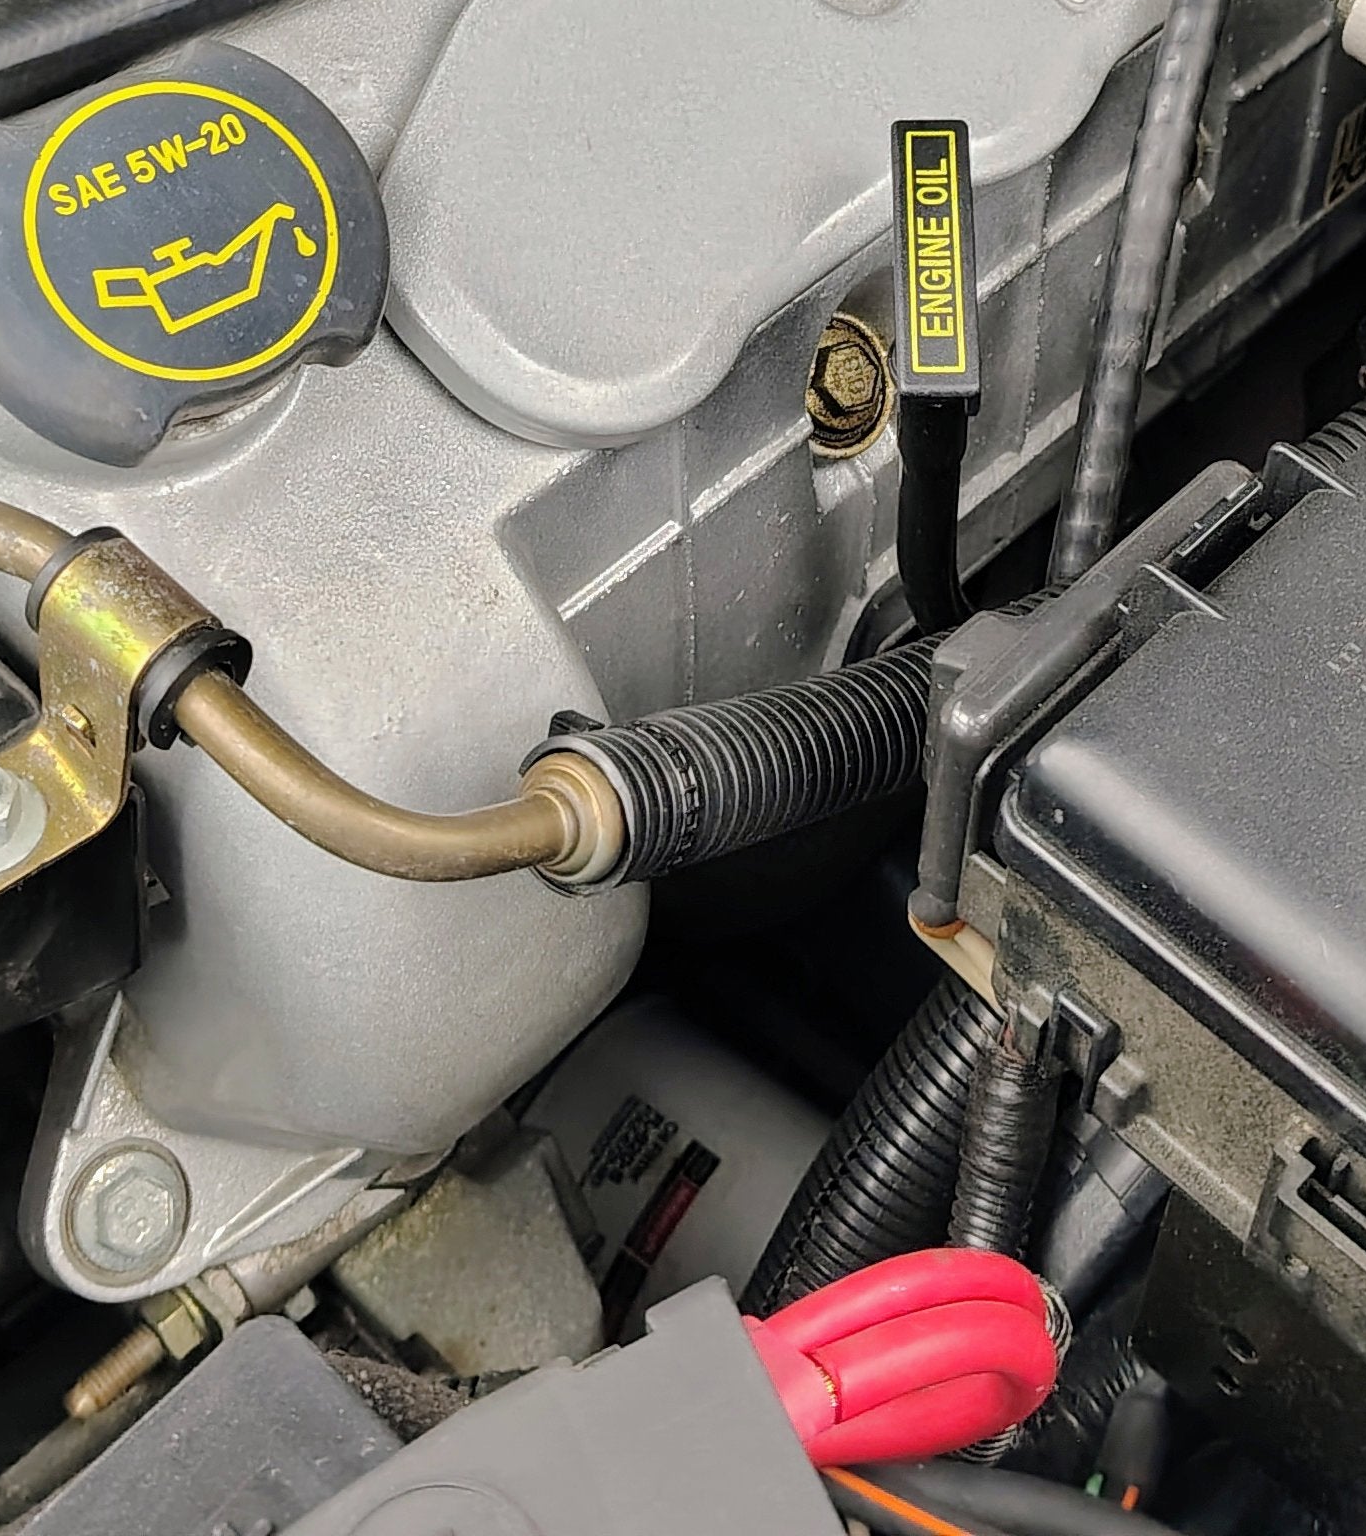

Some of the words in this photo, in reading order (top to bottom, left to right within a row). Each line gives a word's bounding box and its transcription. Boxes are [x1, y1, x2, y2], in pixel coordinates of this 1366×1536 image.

[48, 162, 127, 216] SAE
[125, 112, 247, 184] 5W-20
[915, 157, 949, 207] OIL
[916, 215, 955, 338] ENGINE
